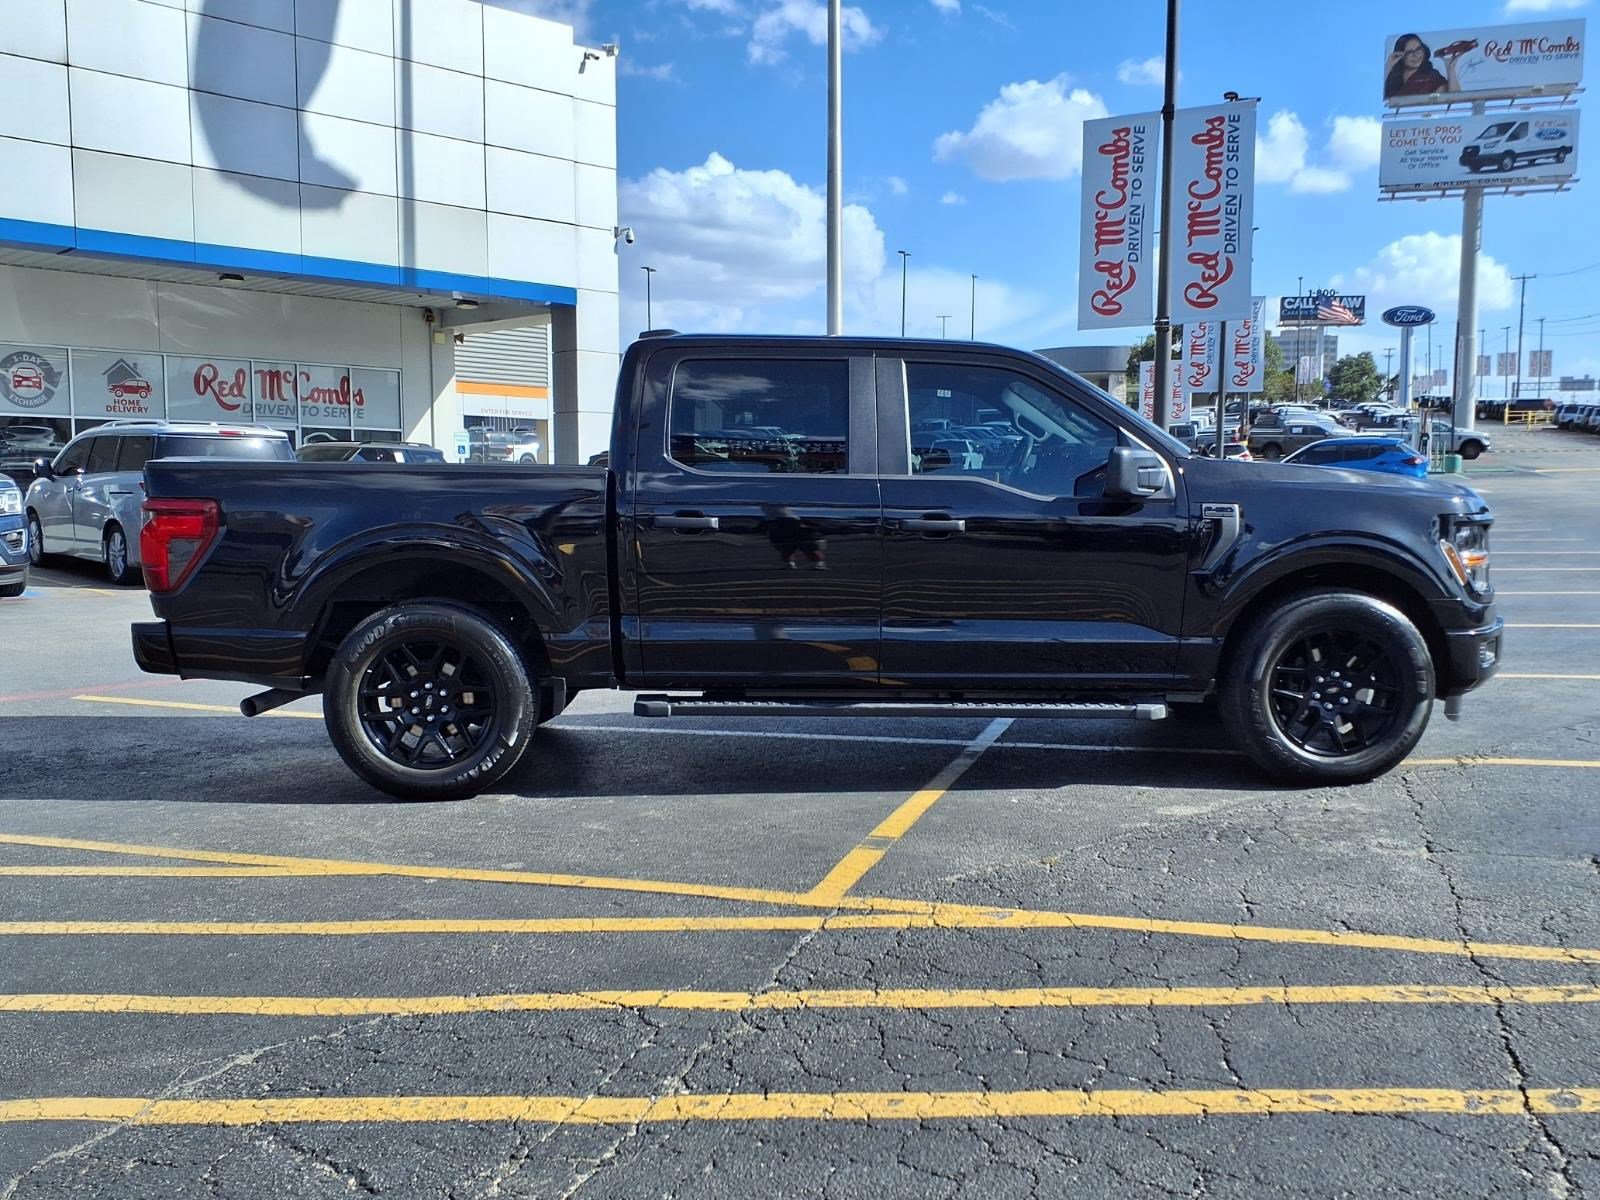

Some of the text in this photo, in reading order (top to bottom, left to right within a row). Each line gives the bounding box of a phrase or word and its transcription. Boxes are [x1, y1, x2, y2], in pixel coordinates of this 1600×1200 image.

[1484, 40, 1513, 63] Red
[1389, 125, 1463, 138] LET THE PROS
[1389, 135, 1462, 148] COME TO YOU
[1128, 125, 1146, 263] DRIVEN TO SERVE
[1224, 114, 1241, 254] DRIVEN TO SERVE
[1091, 126, 1136, 316] Red McCombs
[1184, 115, 1233, 309] Red McCombs
[1393, 309, 1426, 322] Ford
[1188, 362, 1211, 387] Red
[1232, 361, 1255, 387] Red
[194, 363, 365, 411] Red McCombs
[106, 405, 149, 413] DELIVERY
[242, 403, 365, 419] DRIVEN TO SERVE
